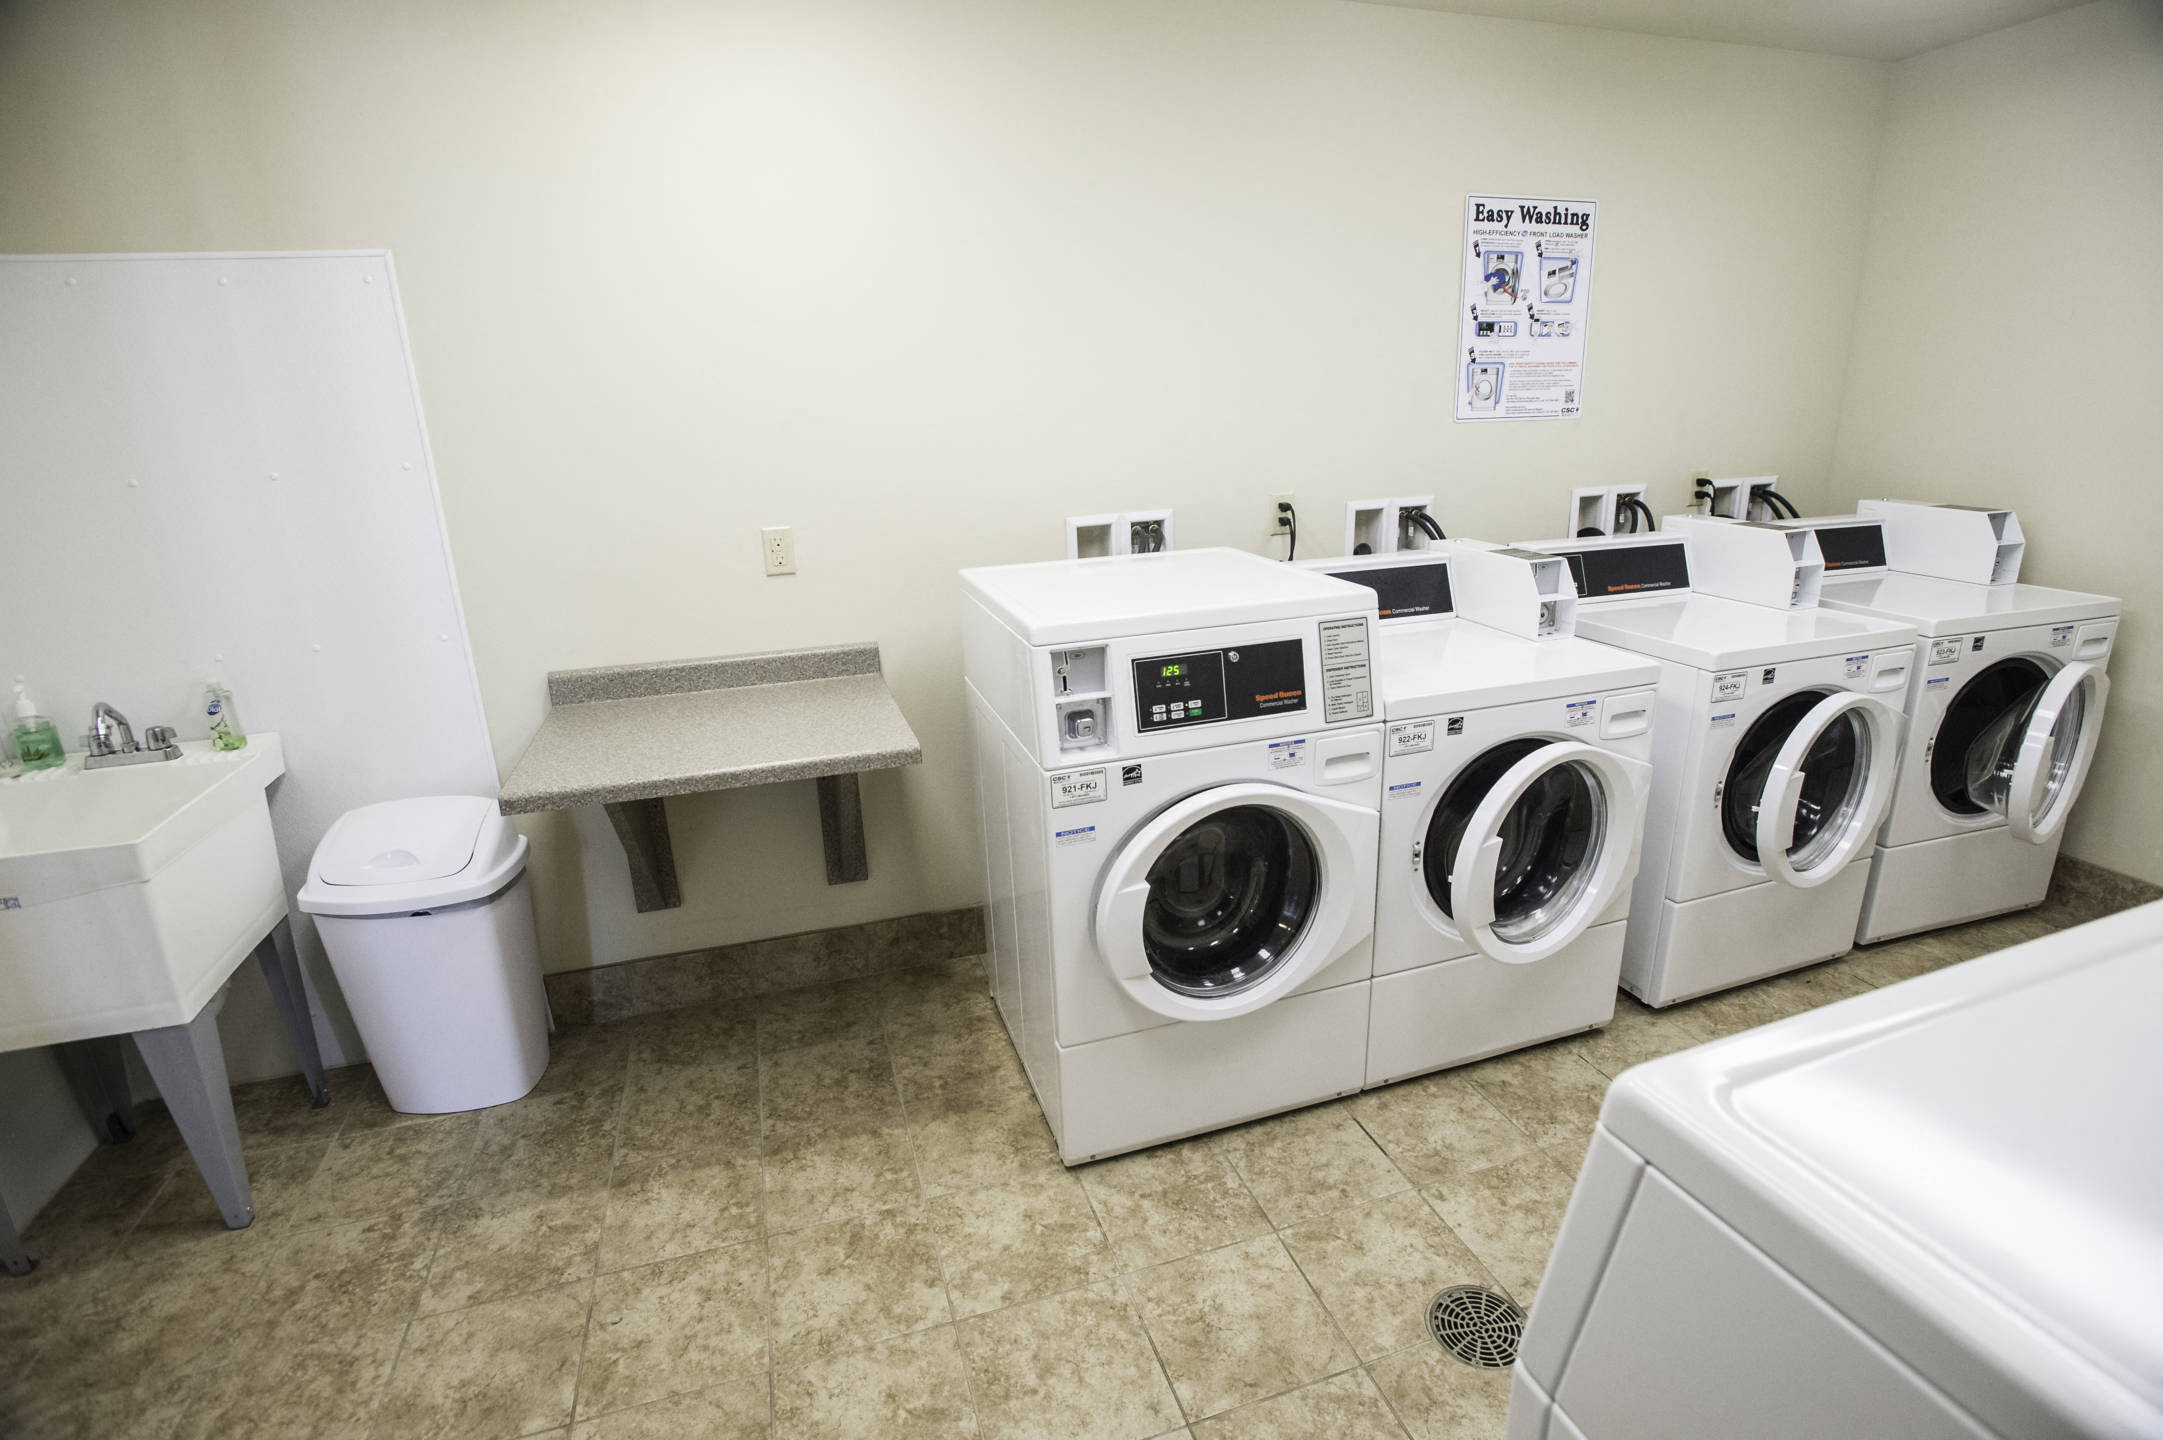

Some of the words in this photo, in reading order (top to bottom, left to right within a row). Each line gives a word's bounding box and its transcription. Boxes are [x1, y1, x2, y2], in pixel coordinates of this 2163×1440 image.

[1473, 203, 1514, 229] Easy
[1518, 205, 1591, 231] Washing
[1472, 229, 1520, 237] HIGH-EFFICIENCY
[1162, 664, 1180, 677] 125
[1255, 693, 1279, 702] Speed
[1279, 690, 1302, 699] Queen
[1259, 699, 1283, 708] Commercial
[1398, 733, 1427, 744] 922-FKJ
[1062, 782, 1097, 794] 921-FKJ
[1060, 826, 1090, 836] NOTICE
